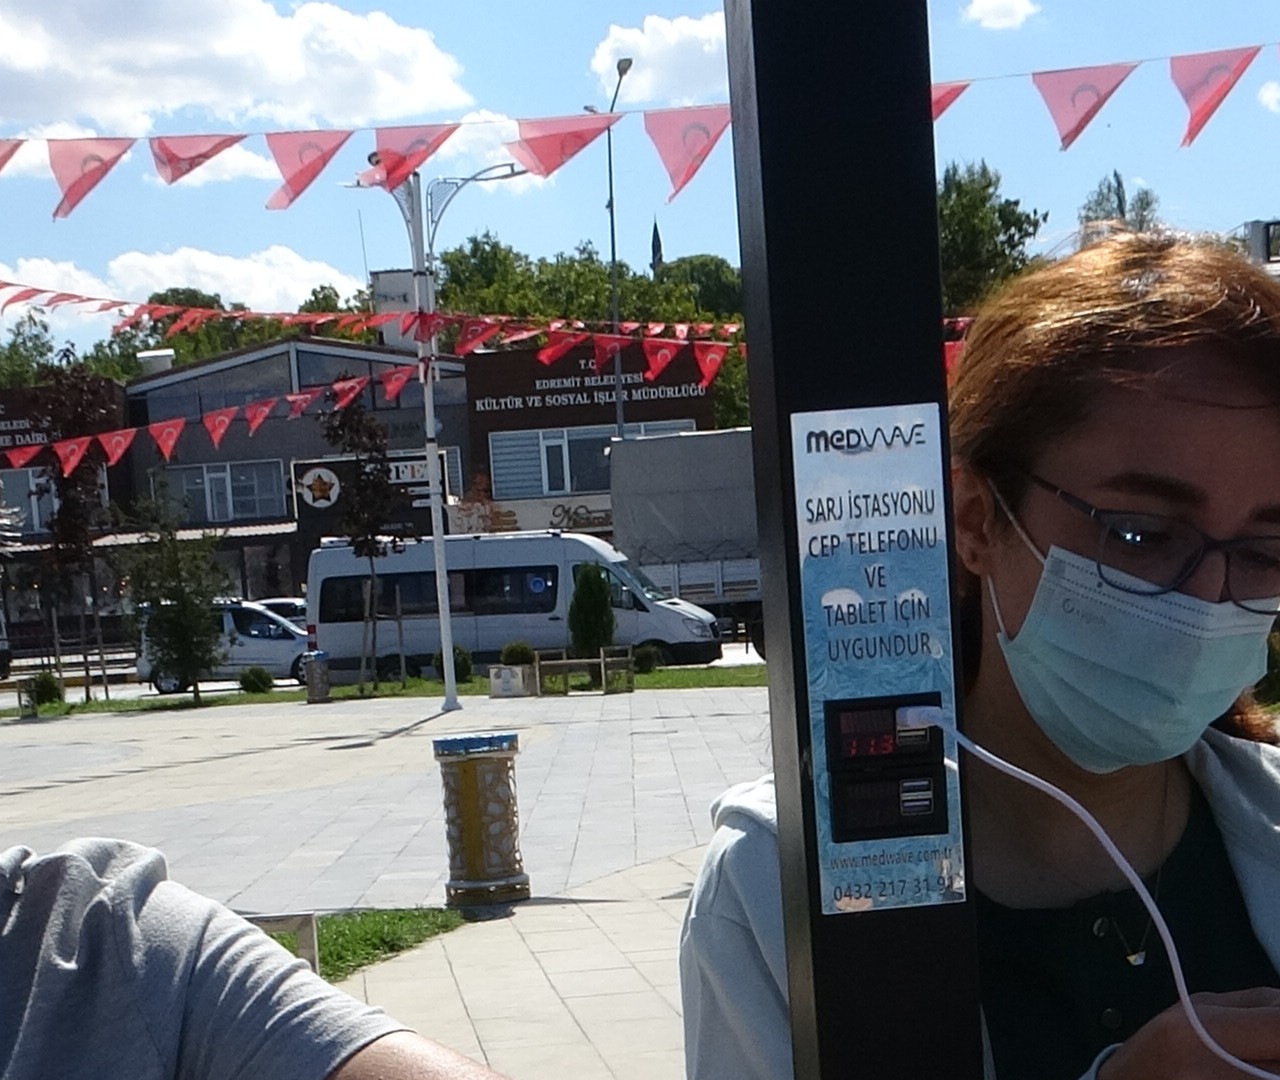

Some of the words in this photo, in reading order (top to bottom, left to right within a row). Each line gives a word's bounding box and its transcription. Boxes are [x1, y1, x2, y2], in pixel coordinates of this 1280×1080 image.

[535, 375, 581, 390] EDREMİT
[584, 372, 644, 387] BELEDYESİ
[475, 394, 523, 411] KÜLTÜR
[526, 396, 542, 408] VE
[546, 392, 591, 406] SOSYAL
[631, 384, 706, 401] MÜDÜRLÜĞÜ
[848, 489, 935, 519] İSTASYONU
[808, 535, 841, 558] CEP
[846, 527, 937, 555] TELEFONU
[864, 566, 887, 588] VE
[823, 601, 887, 627] TABLET
[893, 593, 931, 627] İÇİN
[828, 632, 932, 661] UYGUNDUR
[833, 883, 872, 902] 0432
[878, 880, 907, 897] 217
[914, 877, 932, 894] 31
